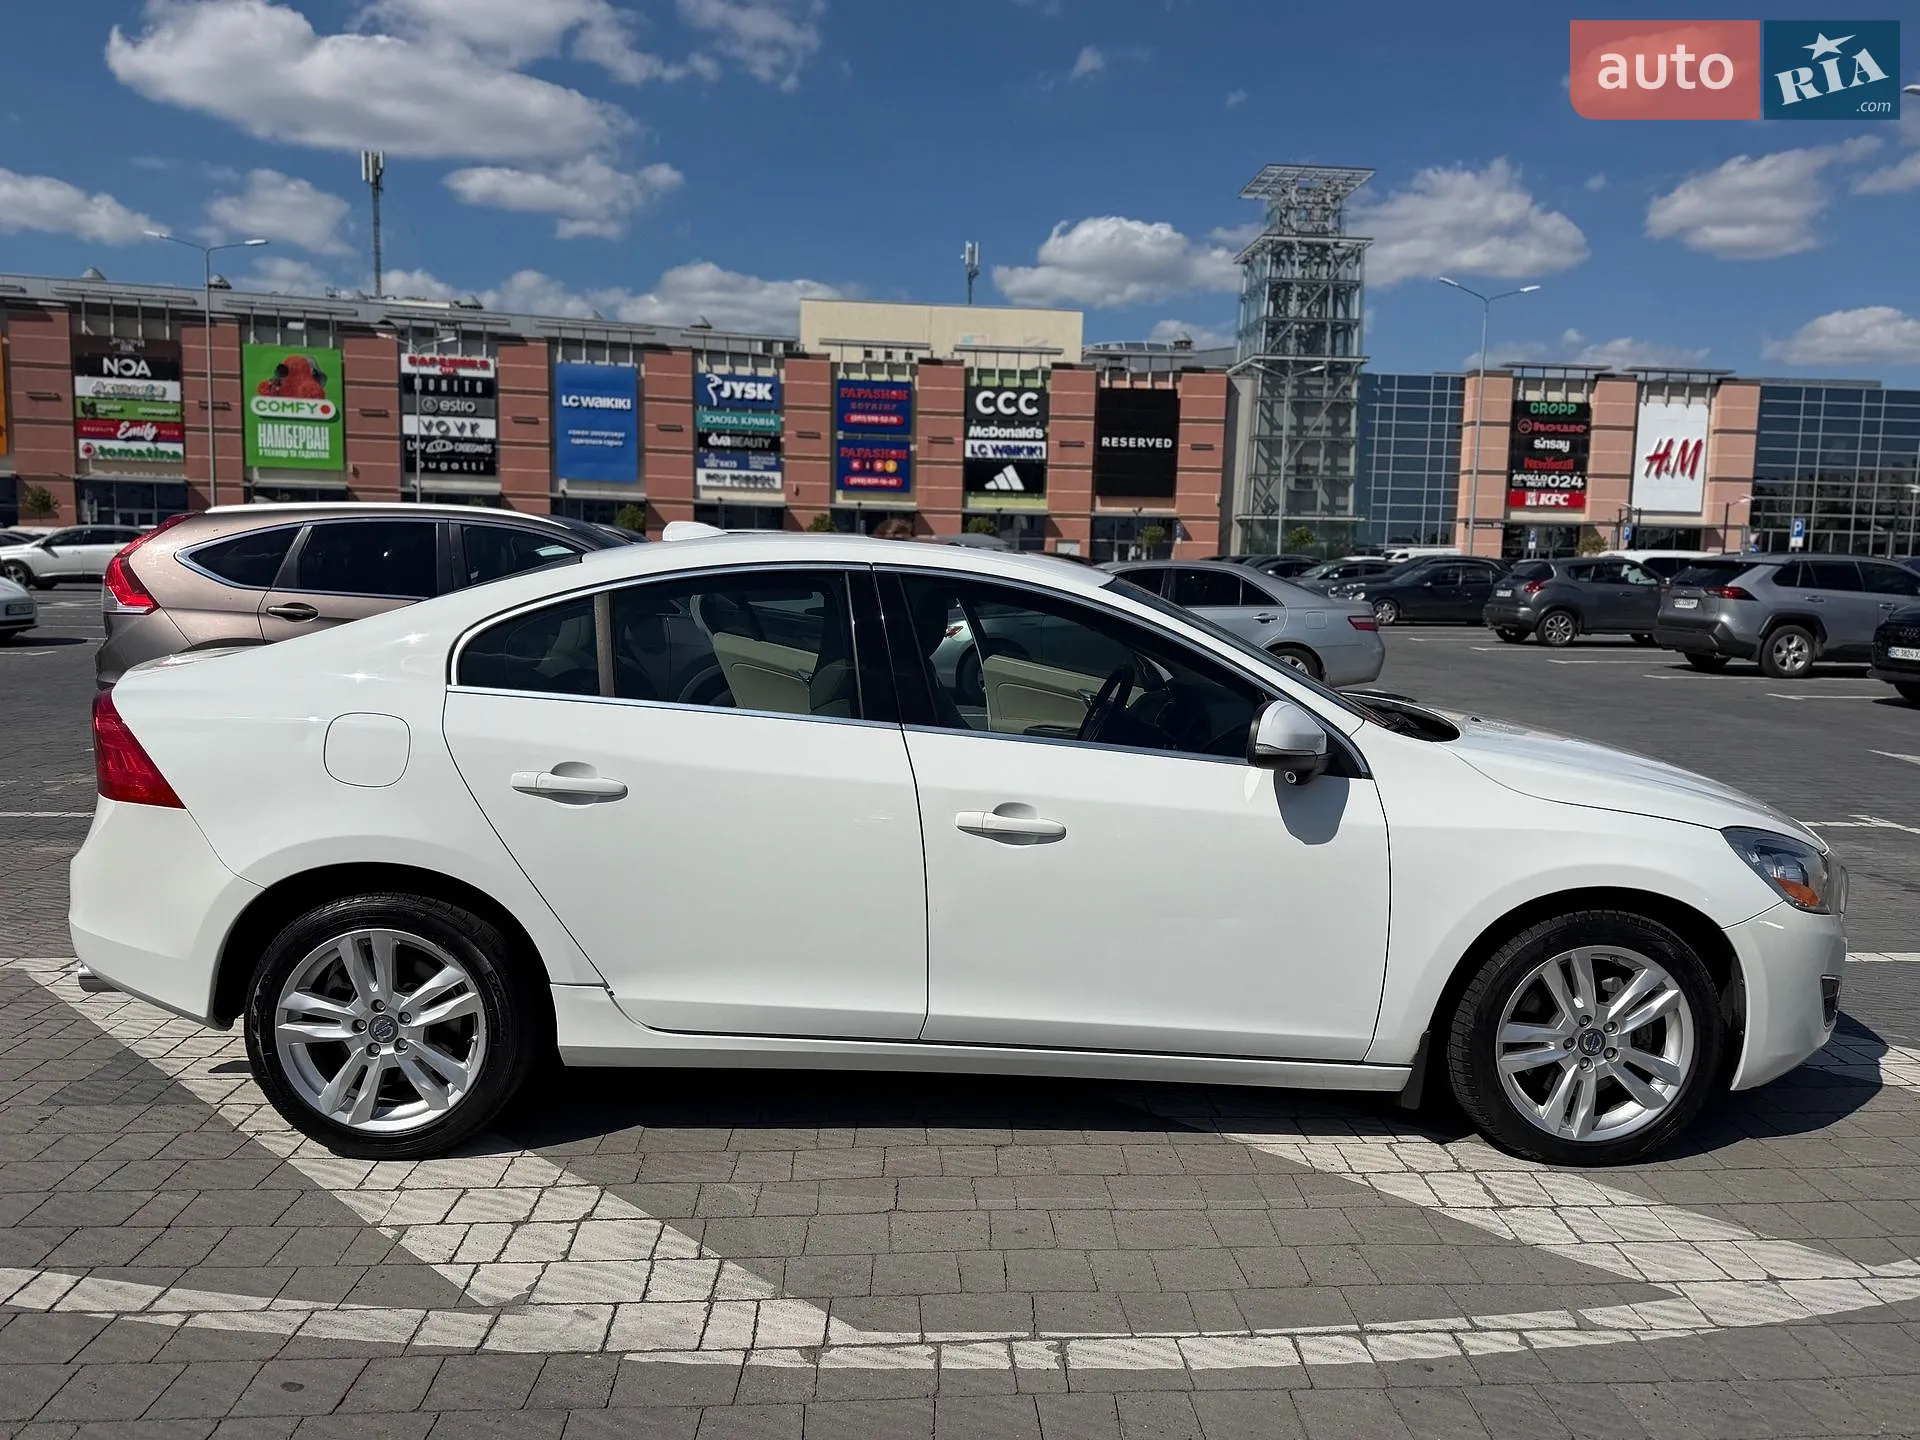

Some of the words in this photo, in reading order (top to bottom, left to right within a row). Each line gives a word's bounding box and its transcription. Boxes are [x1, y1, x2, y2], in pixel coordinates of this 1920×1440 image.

[102, 357, 152, 377] NOA
[720, 381, 773, 401] JYSK
[255, 400, 318, 414] COMFY
[440, 400, 476, 413] estro
[561, 395, 580, 407] LC
[975, 390, 1039, 416] CCC
[1530, 402, 1577, 415] CROPP
[117, 420, 158, 441] Emily
[968, 426, 1044, 440] McDonald's
[1533, 422, 1587, 433] house
[258, 423, 330, 450] НАМБЕРВАН
[1101, 437, 1173, 449] RESERVED
[97, 444, 182, 460] tomatina
[970, 444, 989, 456] LC
[1533, 437, 1570, 453] sinsay
[1644, 437, 1703, 481] H&M
[1539, 494, 1570, 506] KFC
